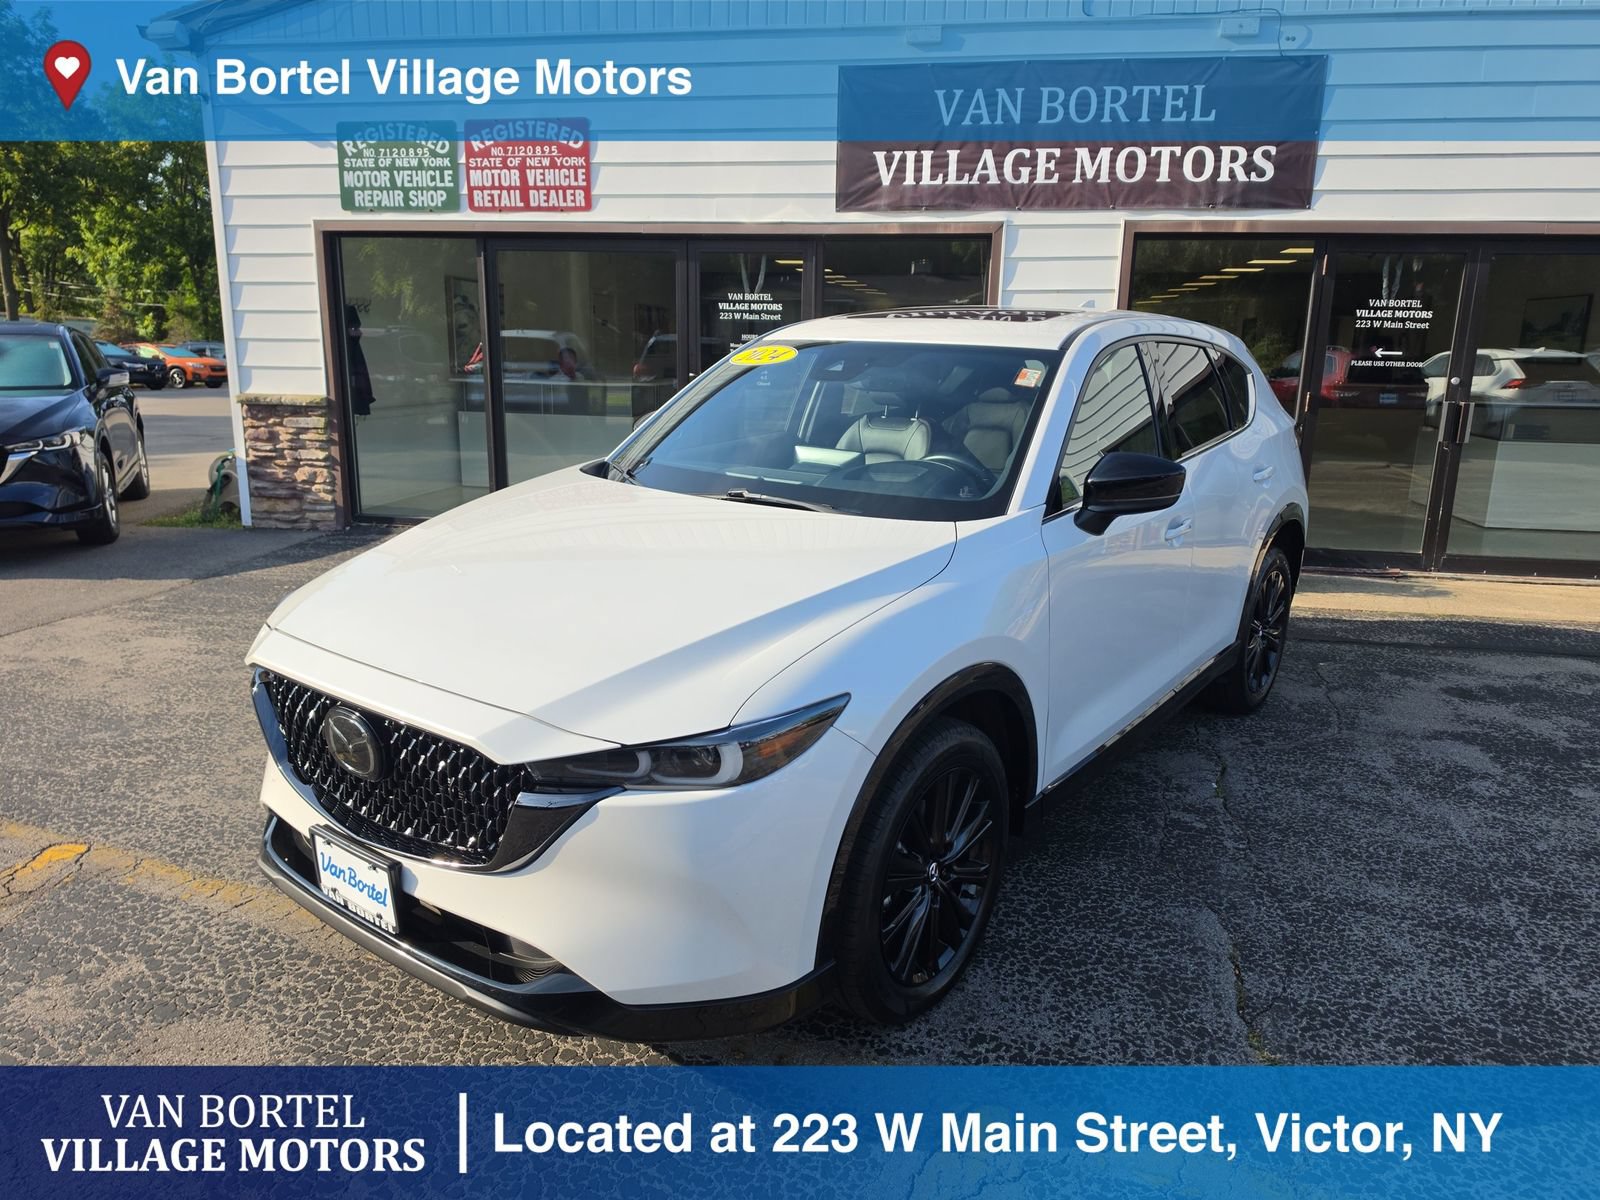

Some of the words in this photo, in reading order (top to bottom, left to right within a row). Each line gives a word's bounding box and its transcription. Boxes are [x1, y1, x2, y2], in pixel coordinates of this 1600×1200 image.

[935, 88, 1025, 127] VAN
[1037, 85, 1217, 125] BORTEL
[342, 122, 450, 157] REGISTERED
[469, 120, 584, 152] REGISTERED
[379, 147, 430, 157] 7120895
[506, 145, 558, 156] 7120895
[344, 158, 375, 168] STATE
[378, 158, 392, 167] OF
[395, 158, 418, 167] NEW
[422, 157, 451, 167] YORK
[468, 158, 502, 167] STATE
[507, 157, 522, 167] OF
[526, 157, 550, 167] NEW
[554, 156, 586, 167] YORK
[872, 147, 1061, 187] VILLAGE
[1073, 145, 1277, 184] MOTORS
[343, 170, 390, 188] MOTOR
[393, 169, 454, 187] VEHICLE
[469, 169, 520, 187] MOTOR
[526, 168, 587, 186] VEHICLE
[354, 190, 404, 207] REPAIR
[408, 190, 446, 207] SHOP
[473, 189, 524, 207] RETAIL
[529, 189, 585, 207] DEALER
[728, 293, 743, 301] VAN
[744, 293, 773, 301] BORTEL
[718, 302, 750, 311] VILLAGE
[750, 303, 783, 311] MOTORS
[1368, 299, 1388, 308] VAN
[1388, 299, 1423, 308] BORTEL
[719, 312, 733, 320] 223
[733, 312, 742, 320] W
[742, 312, 760, 320] Main
[760, 312, 781, 320] Street
[1356, 309, 1393, 318] VILLAGE
[1394, 310, 1433, 319] MOTORS
[1355, 319, 1371, 328] 223
[1373, 320, 1383, 328] W
[1383, 320, 1403, 329] Main
[1405, 321, 1430, 329] Street
